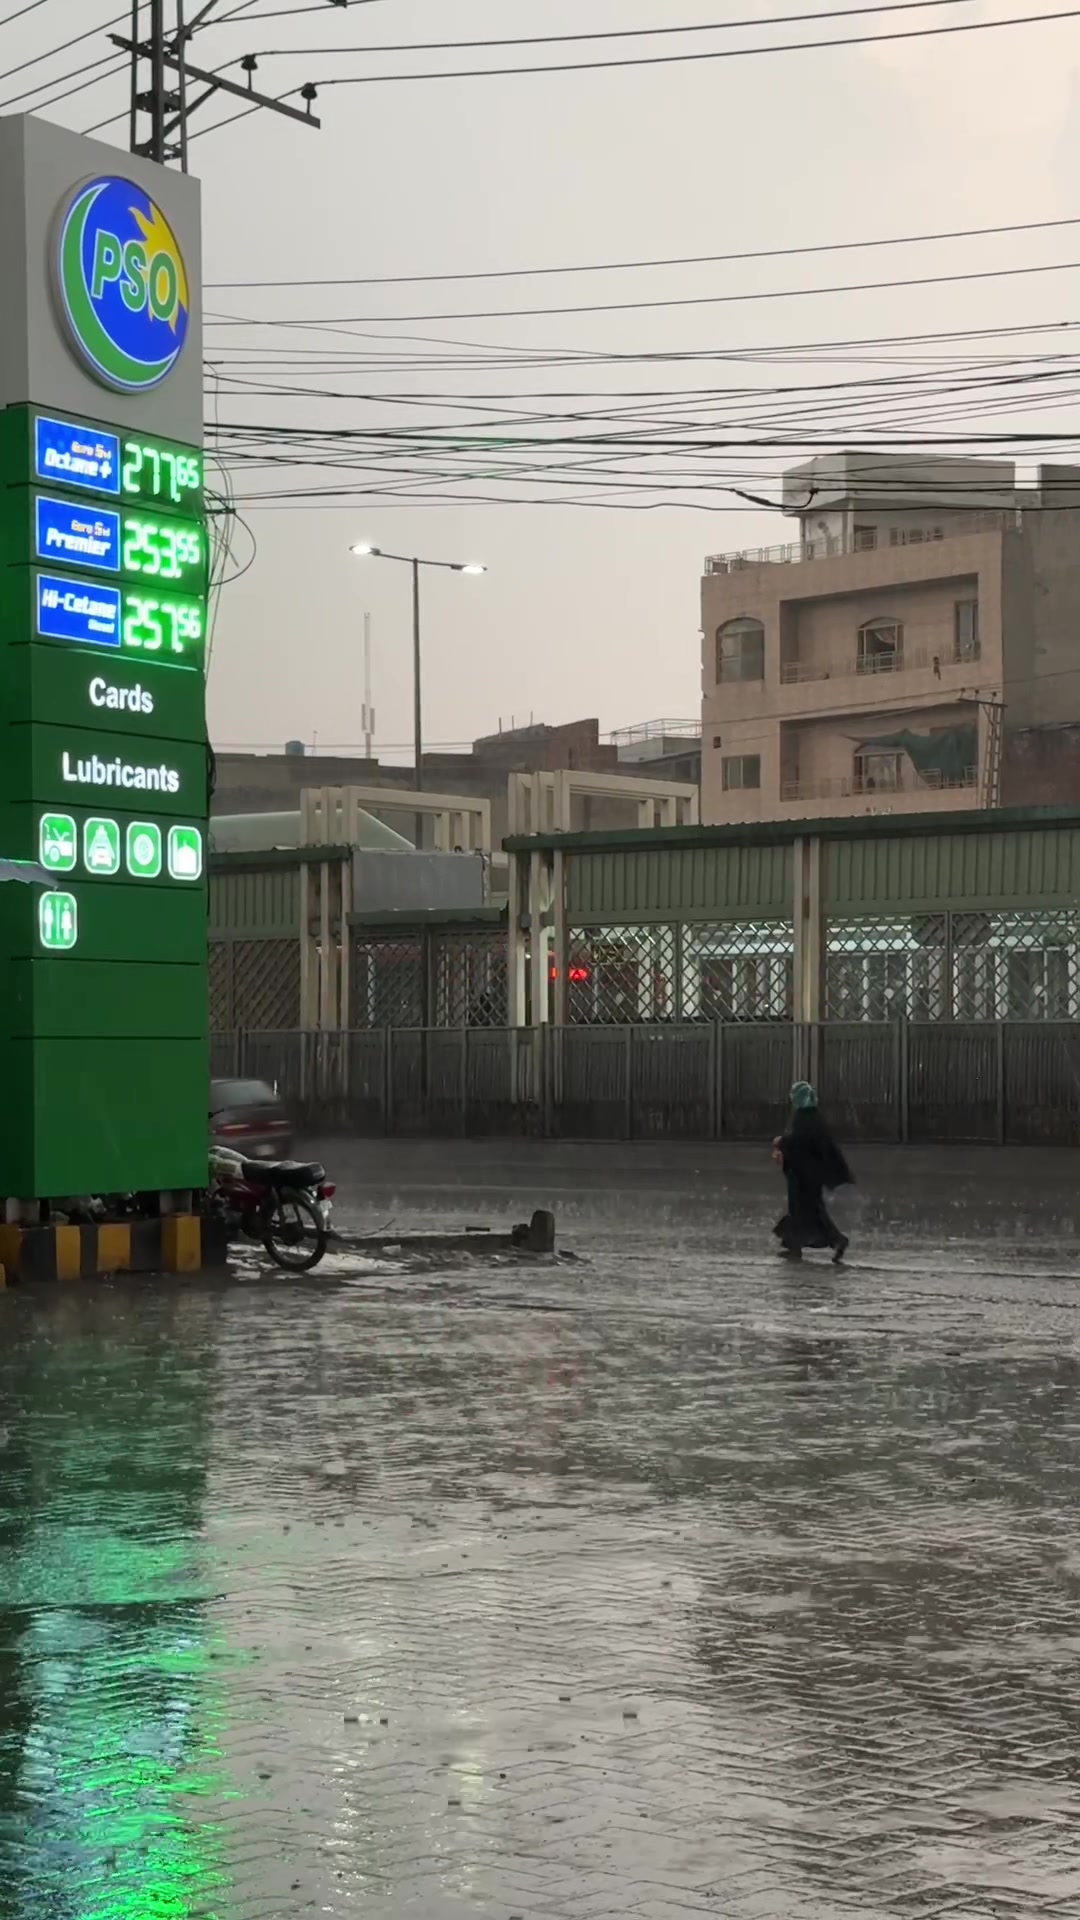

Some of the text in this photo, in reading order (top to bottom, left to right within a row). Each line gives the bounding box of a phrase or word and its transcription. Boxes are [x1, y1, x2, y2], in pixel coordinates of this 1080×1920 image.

[91, 228, 178, 322] PSO
[123, 442, 200, 502] 277.65
[46, 527, 112, 556] Premier
[89, 677, 154, 713] Cards
[62, 751, 180, 793] Lubricants
